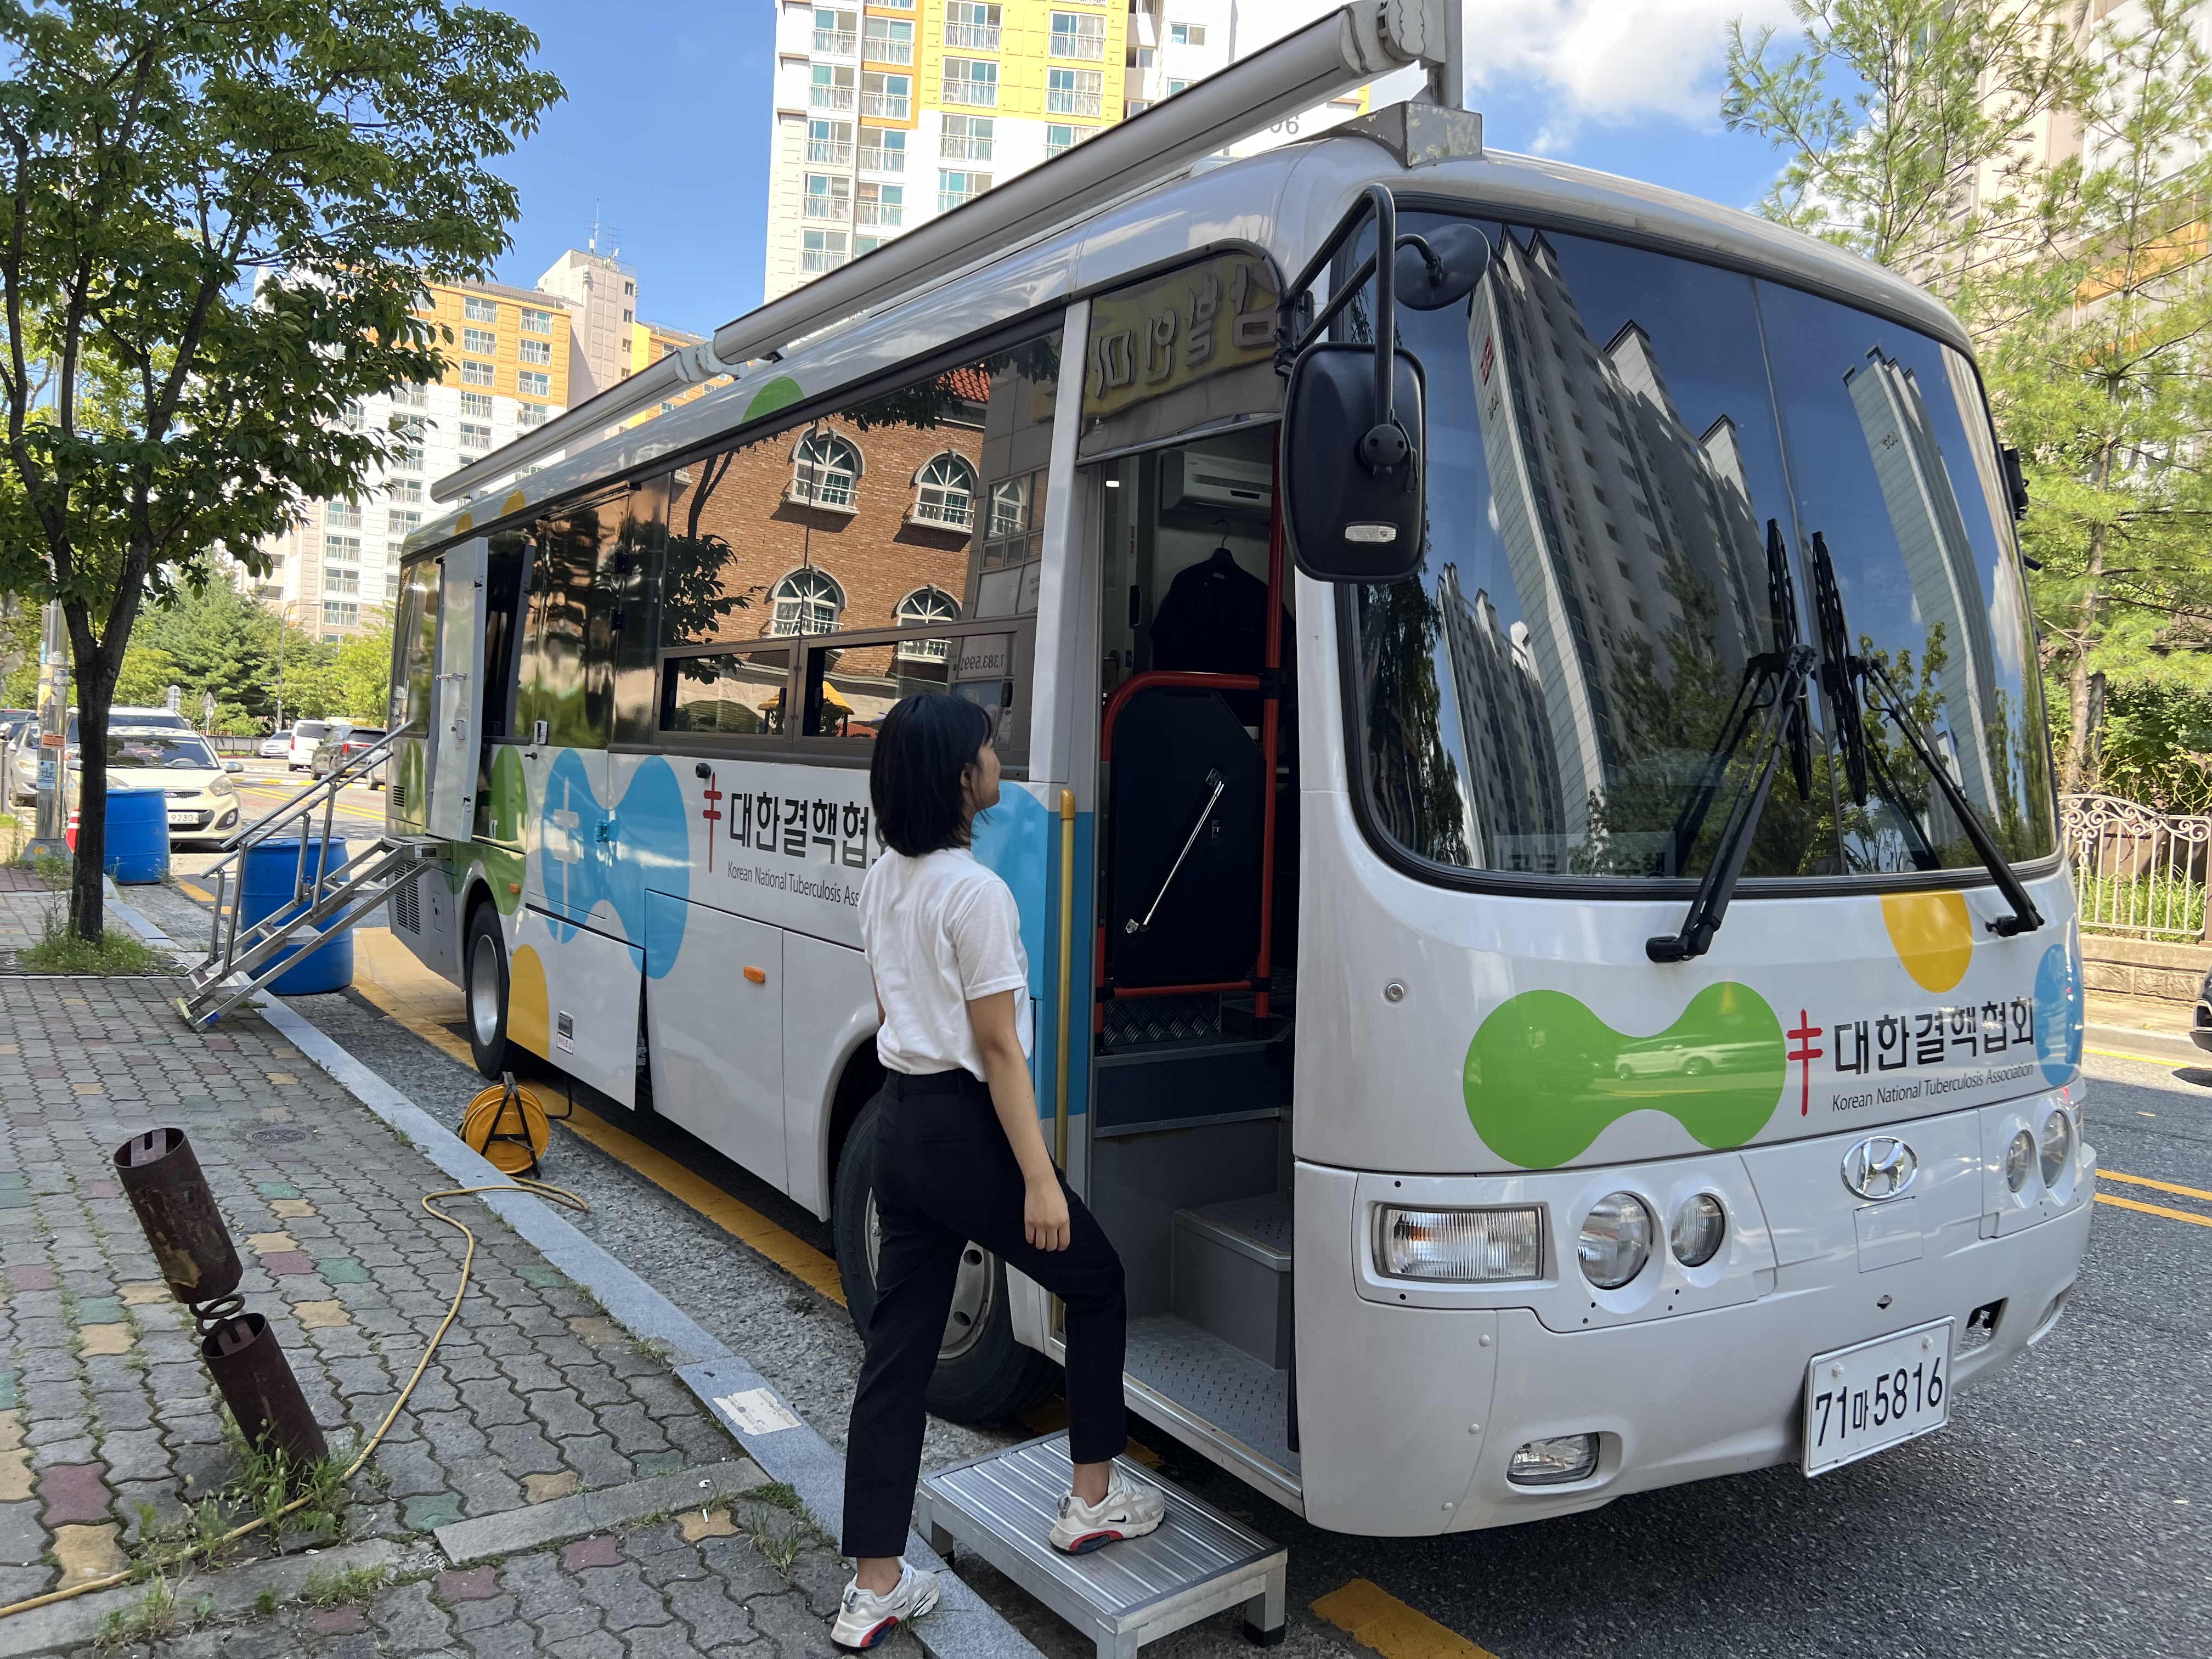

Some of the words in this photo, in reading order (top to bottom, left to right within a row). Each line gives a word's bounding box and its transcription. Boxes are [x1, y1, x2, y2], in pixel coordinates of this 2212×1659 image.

[727, 861, 753, 883] Korean
[755, 866, 787, 891] National
[789, 873, 841, 903] Tuberculosis
[1834, 996, 2035, 1075] 대한결핵협회
[1832, 1092, 1872, 1112] Korean
[1876, 1079, 1922, 1105] National
[1924, 1070, 1983, 1096] Tuberculosis
[1985, 1063, 2034, 1084] Association
[1815, 1356, 1943, 1448] 71마5816
